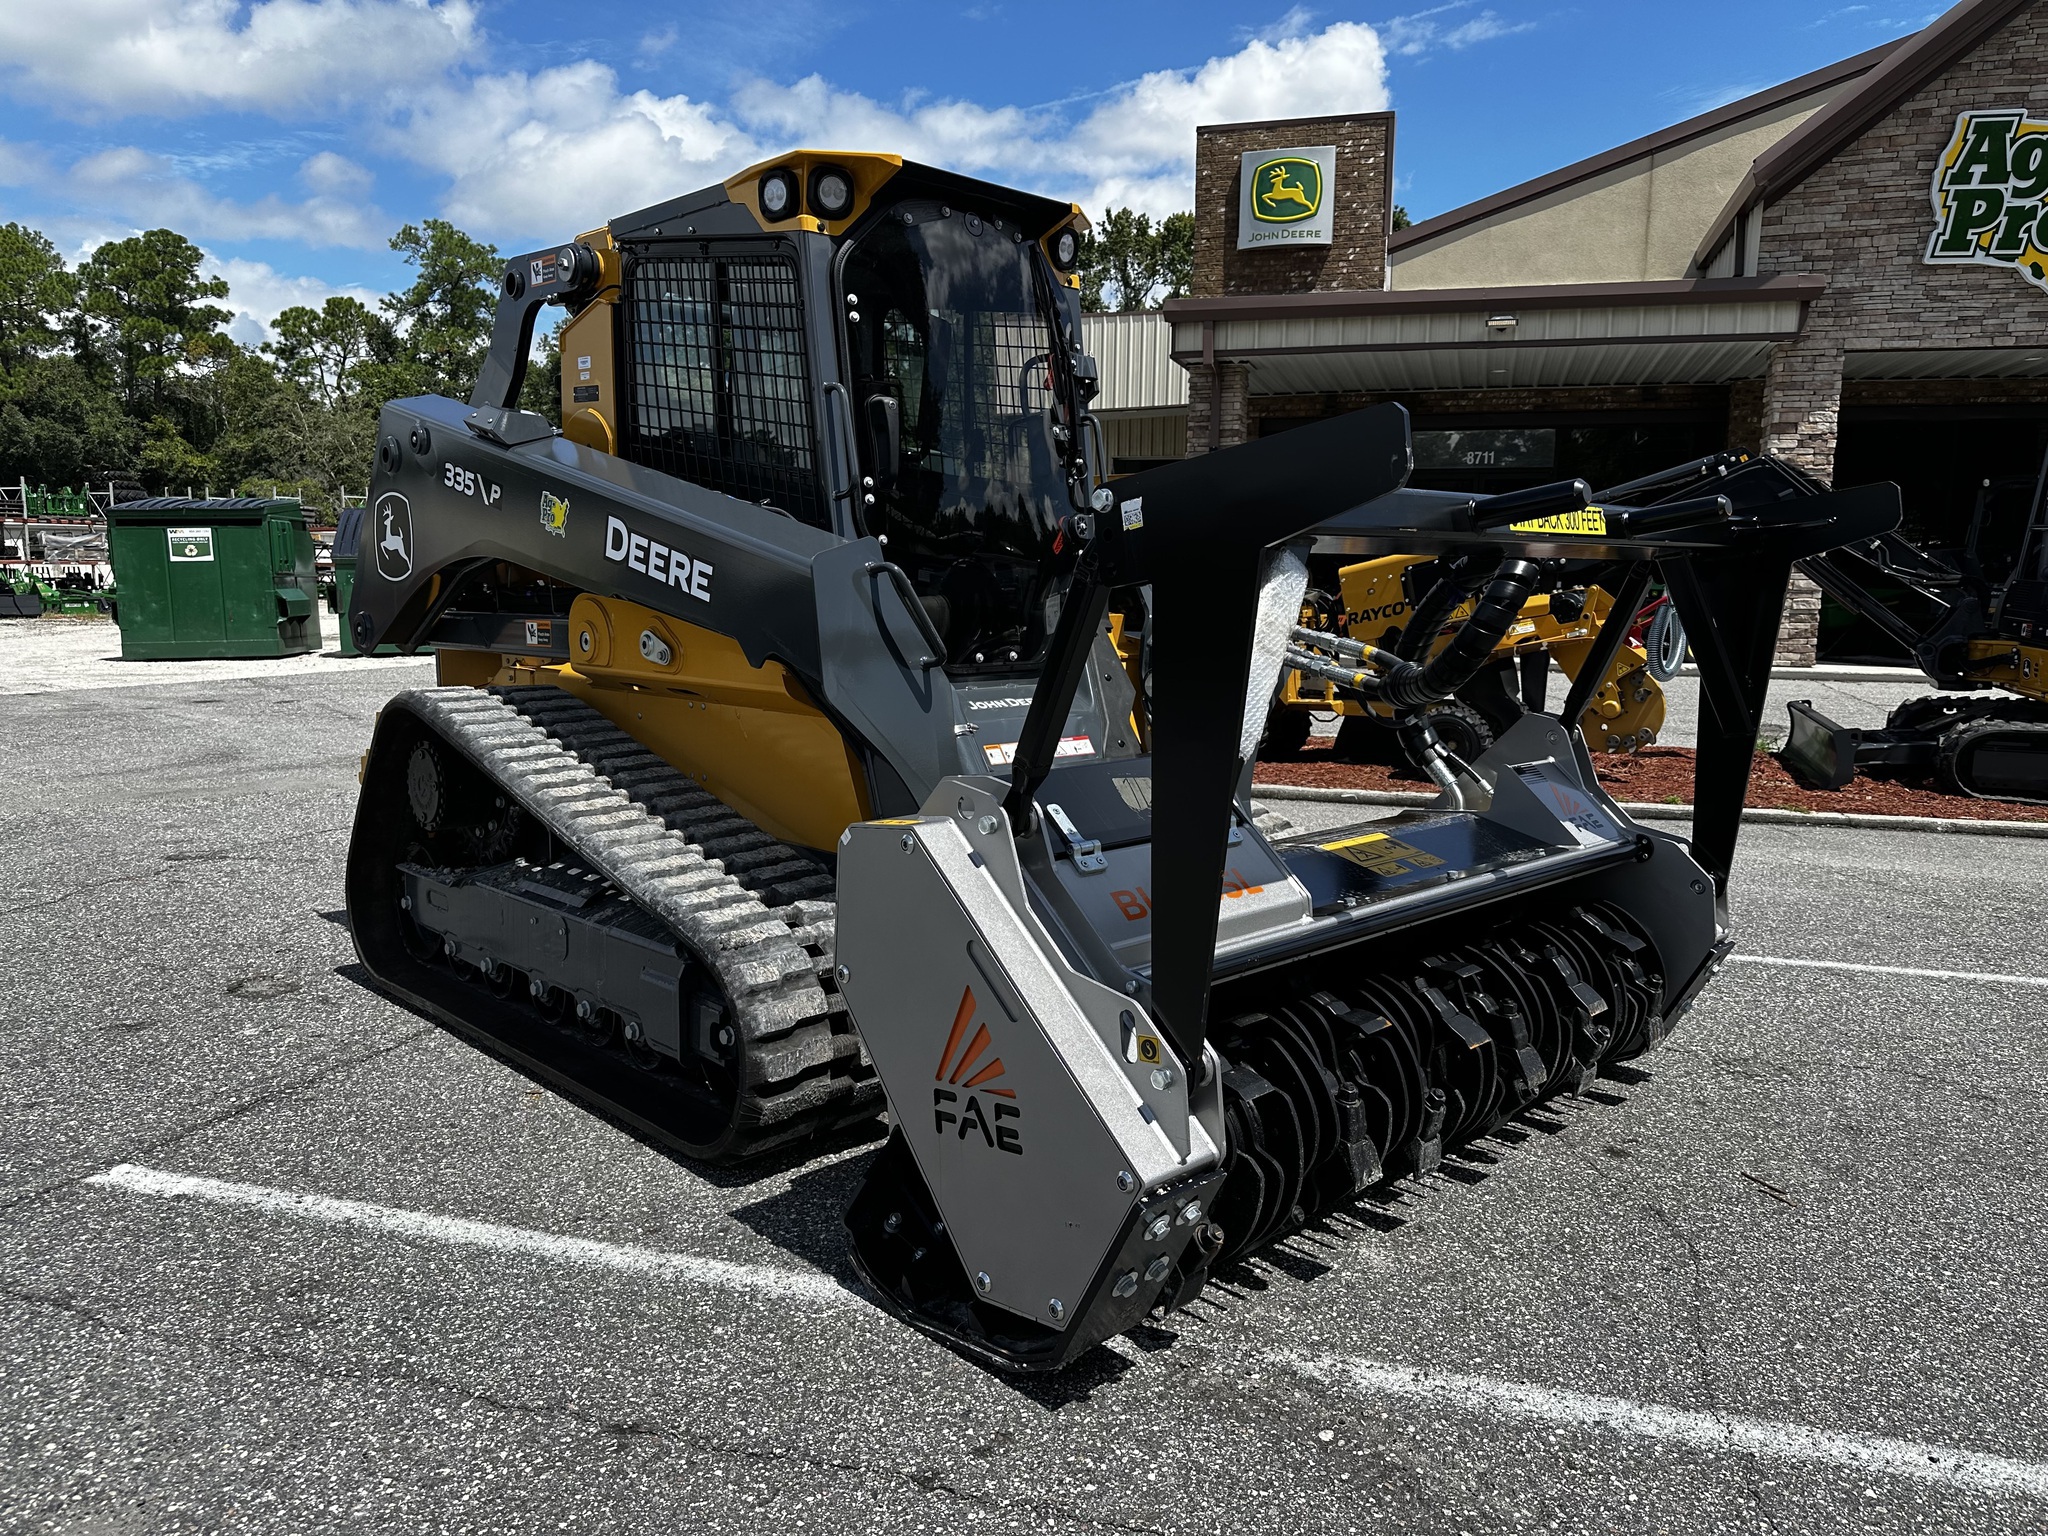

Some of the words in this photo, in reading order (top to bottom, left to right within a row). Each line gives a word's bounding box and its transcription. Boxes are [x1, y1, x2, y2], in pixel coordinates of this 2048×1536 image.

[1248, 231, 1280, 242] JOHN
[1281, 229, 1322, 239] DEERE
[1466, 450, 1495, 464] 8711
[1581, 510, 1603, 531] FEET
[605, 515, 713, 603] DEERE
[1348, 601, 1405, 626] RAYCO
[968, 699, 1008, 710] JOHN
[1568, 812, 1605, 833] FAE
[933, 1087, 1024, 1156] FAE
